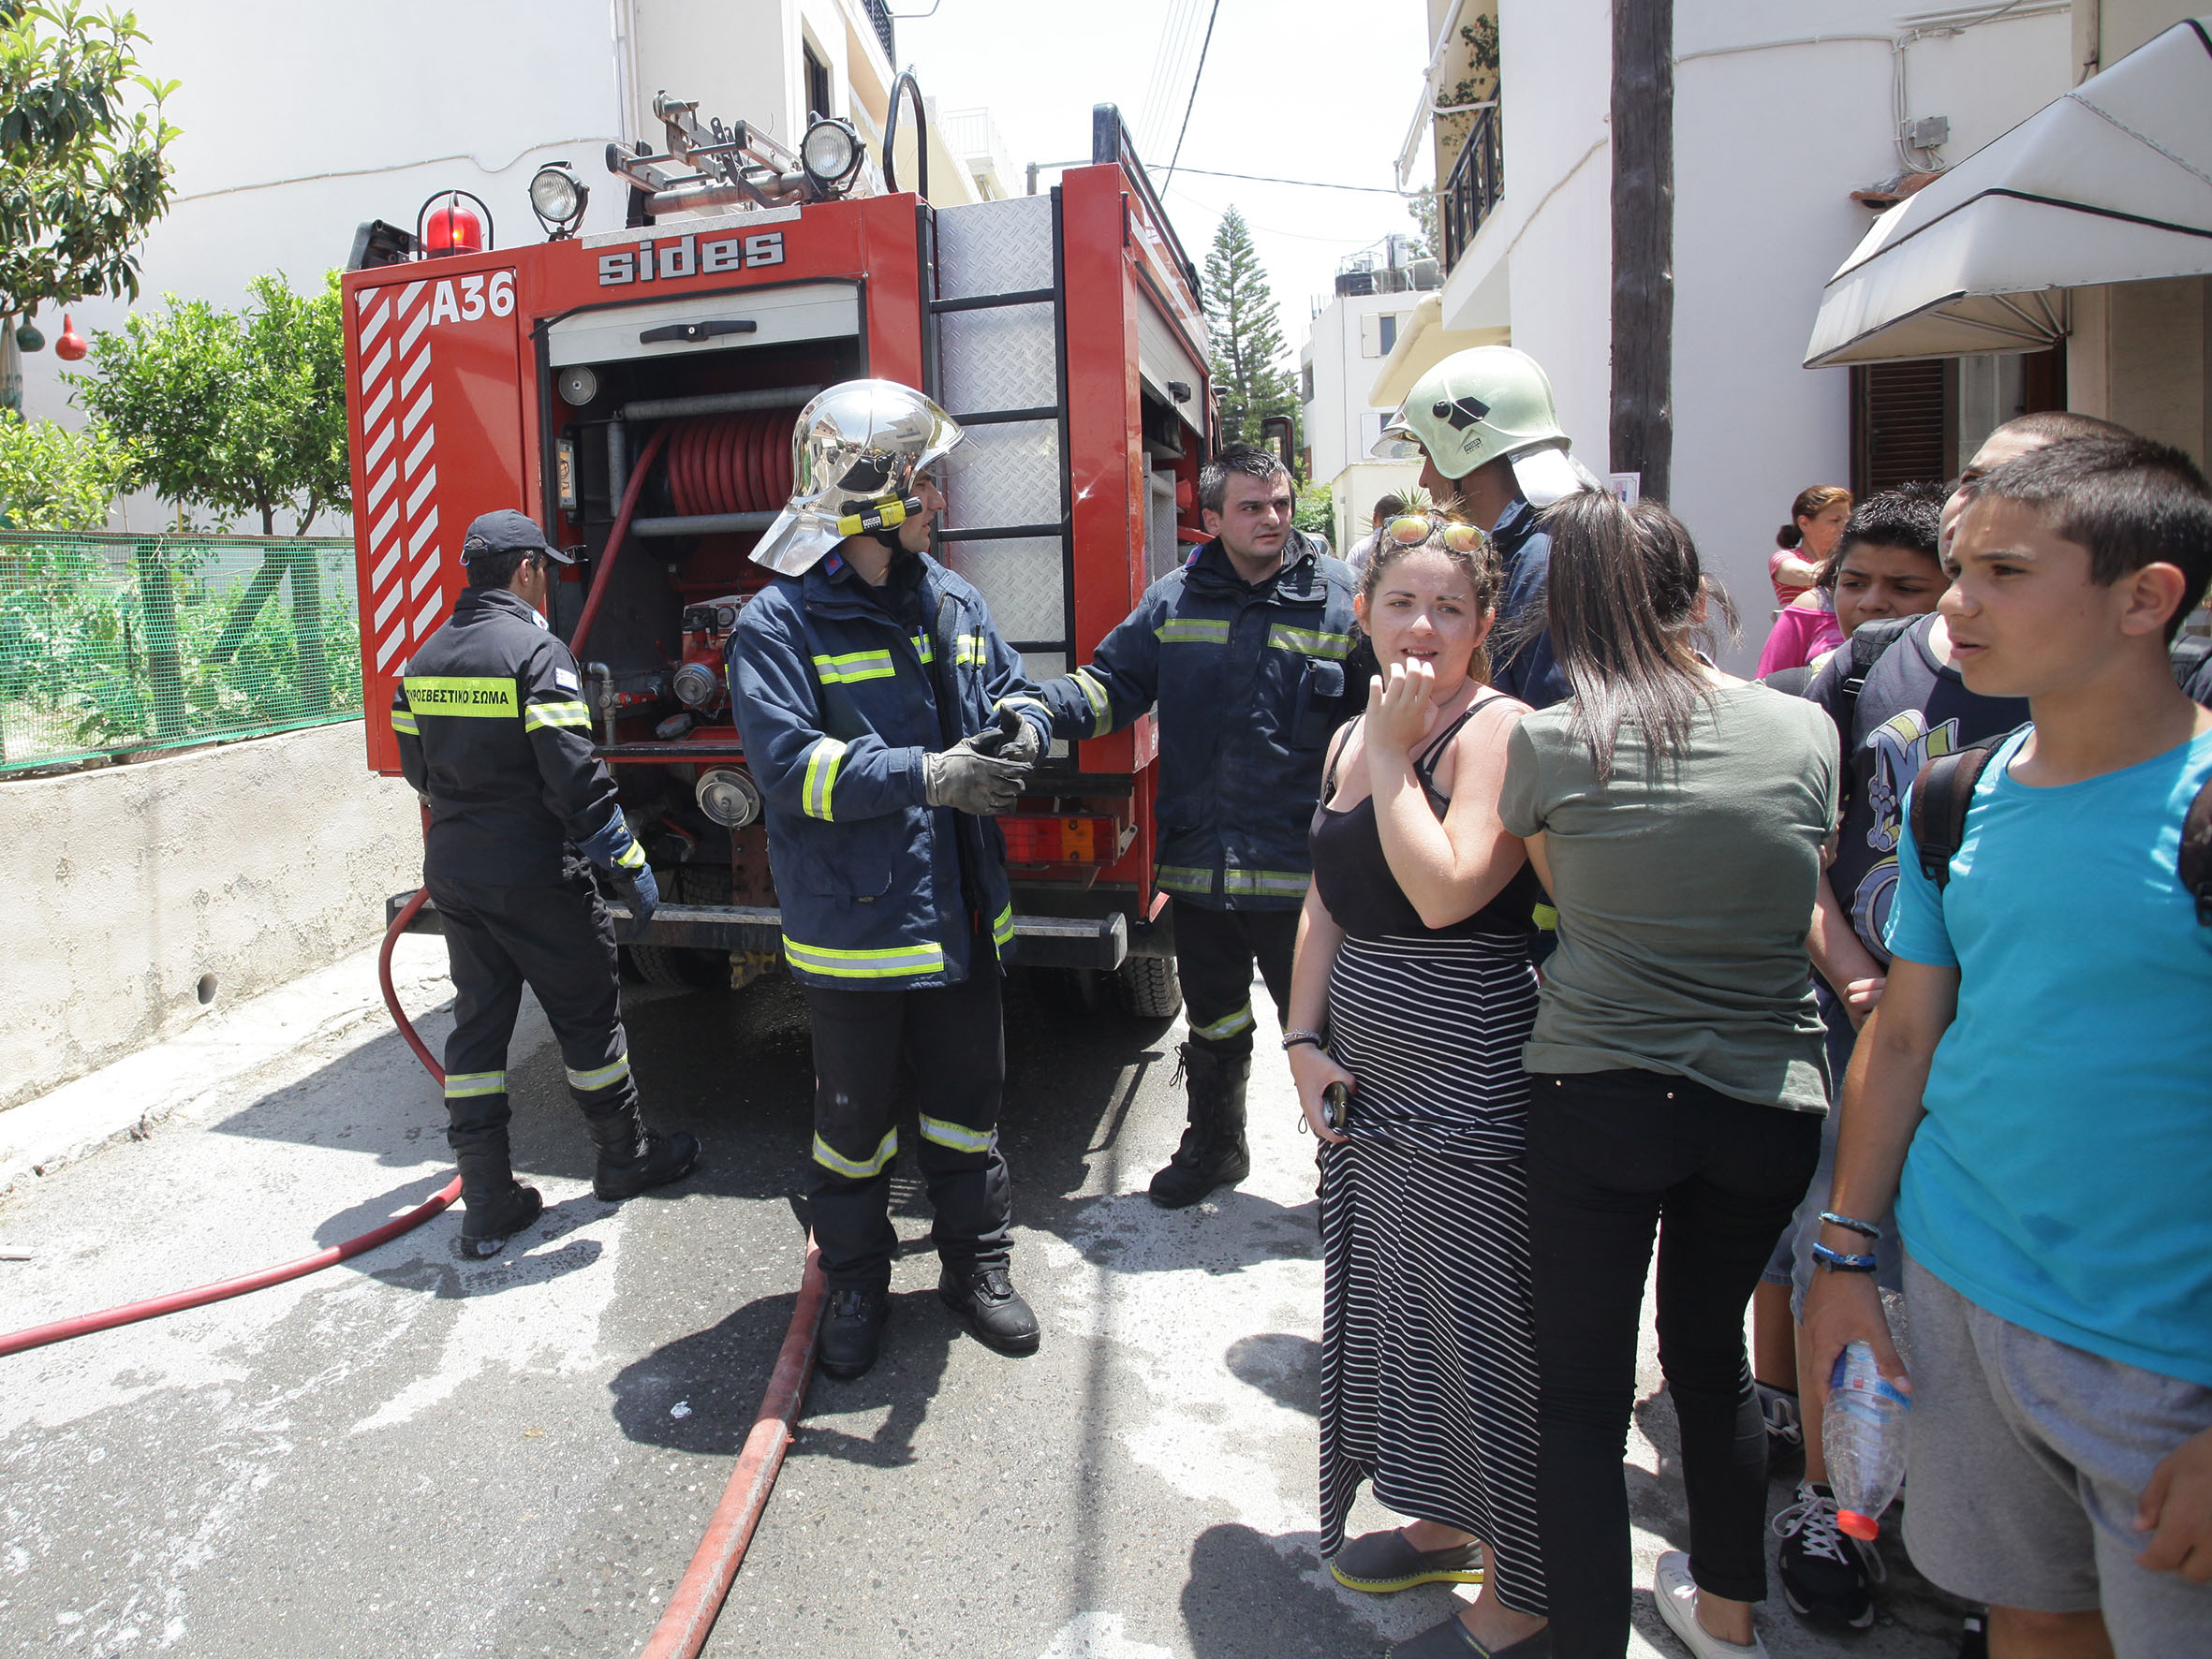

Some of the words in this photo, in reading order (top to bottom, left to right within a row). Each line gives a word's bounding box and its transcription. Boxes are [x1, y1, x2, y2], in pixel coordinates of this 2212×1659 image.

[598, 230, 785, 285] sides
[430, 270, 516, 326] A36
[472, 690, 509, 705] ΣΩΜΑ
